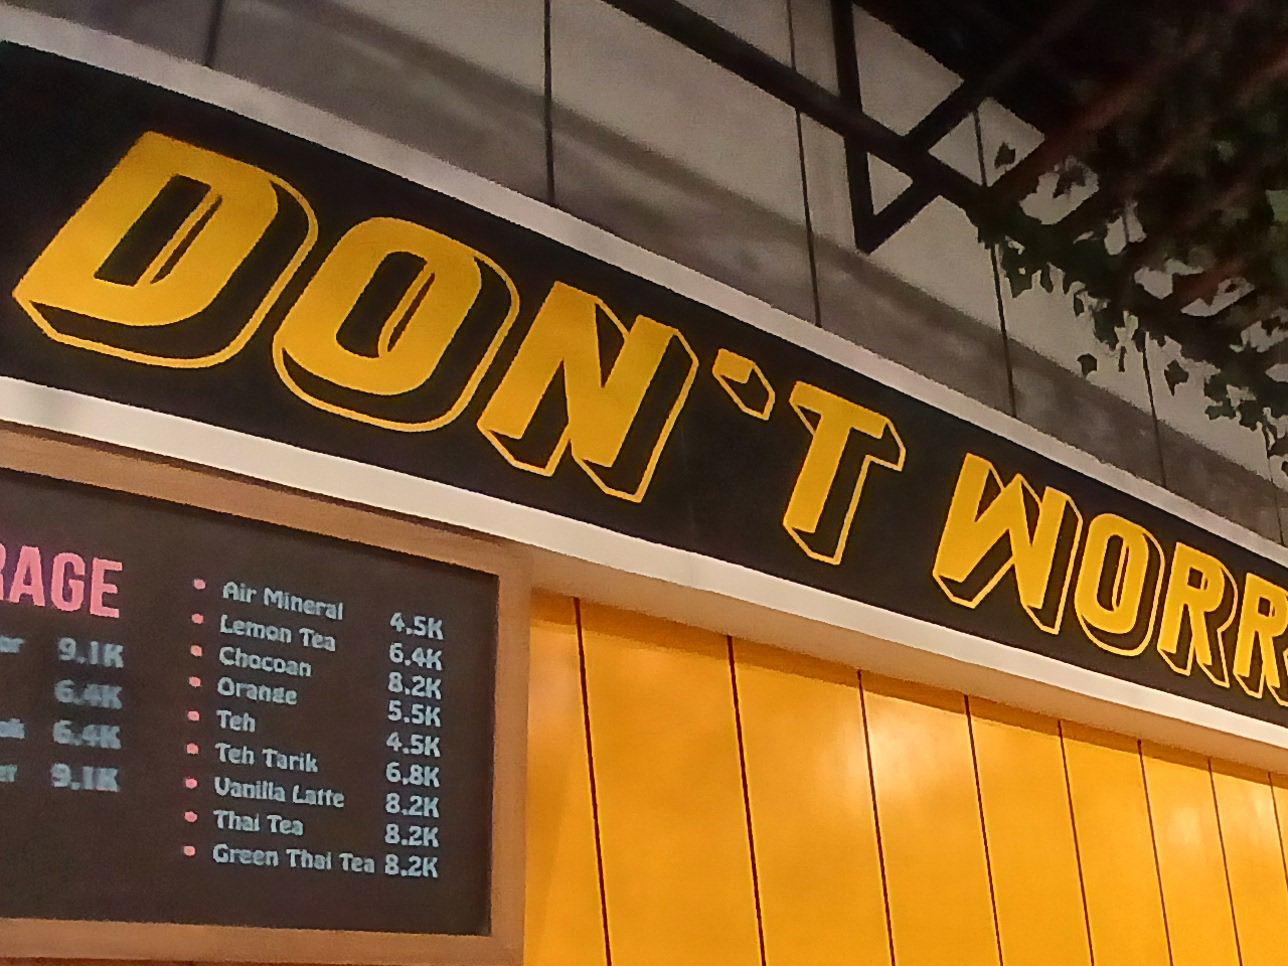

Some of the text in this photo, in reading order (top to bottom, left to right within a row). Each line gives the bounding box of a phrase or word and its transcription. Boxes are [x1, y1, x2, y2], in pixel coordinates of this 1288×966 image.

[12, 129, 906, 566] DON'T
[0, 543, 123, 619] AGE
[222, 581, 445, 641] Air Mineral 4.5K
[57, 636, 125, 669] 9.1K
[219, 614, 444, 672] Lemon Tea 6.4K
[218, 645, 443, 701] Chocoan 8.2K
[215, 709, 442, 758] Teh 4.5K
[387, 699, 442, 728] 5.5K
[214, 742, 441, 788] Teh Tarik 6.8K
[292, 784, 346, 808] Latte
[385, 792, 440, 818] 8.2K
[212, 809, 439, 848] Thai Tea 8.2K
[212, 843, 439, 878] Green Thai Tea 8.2K
